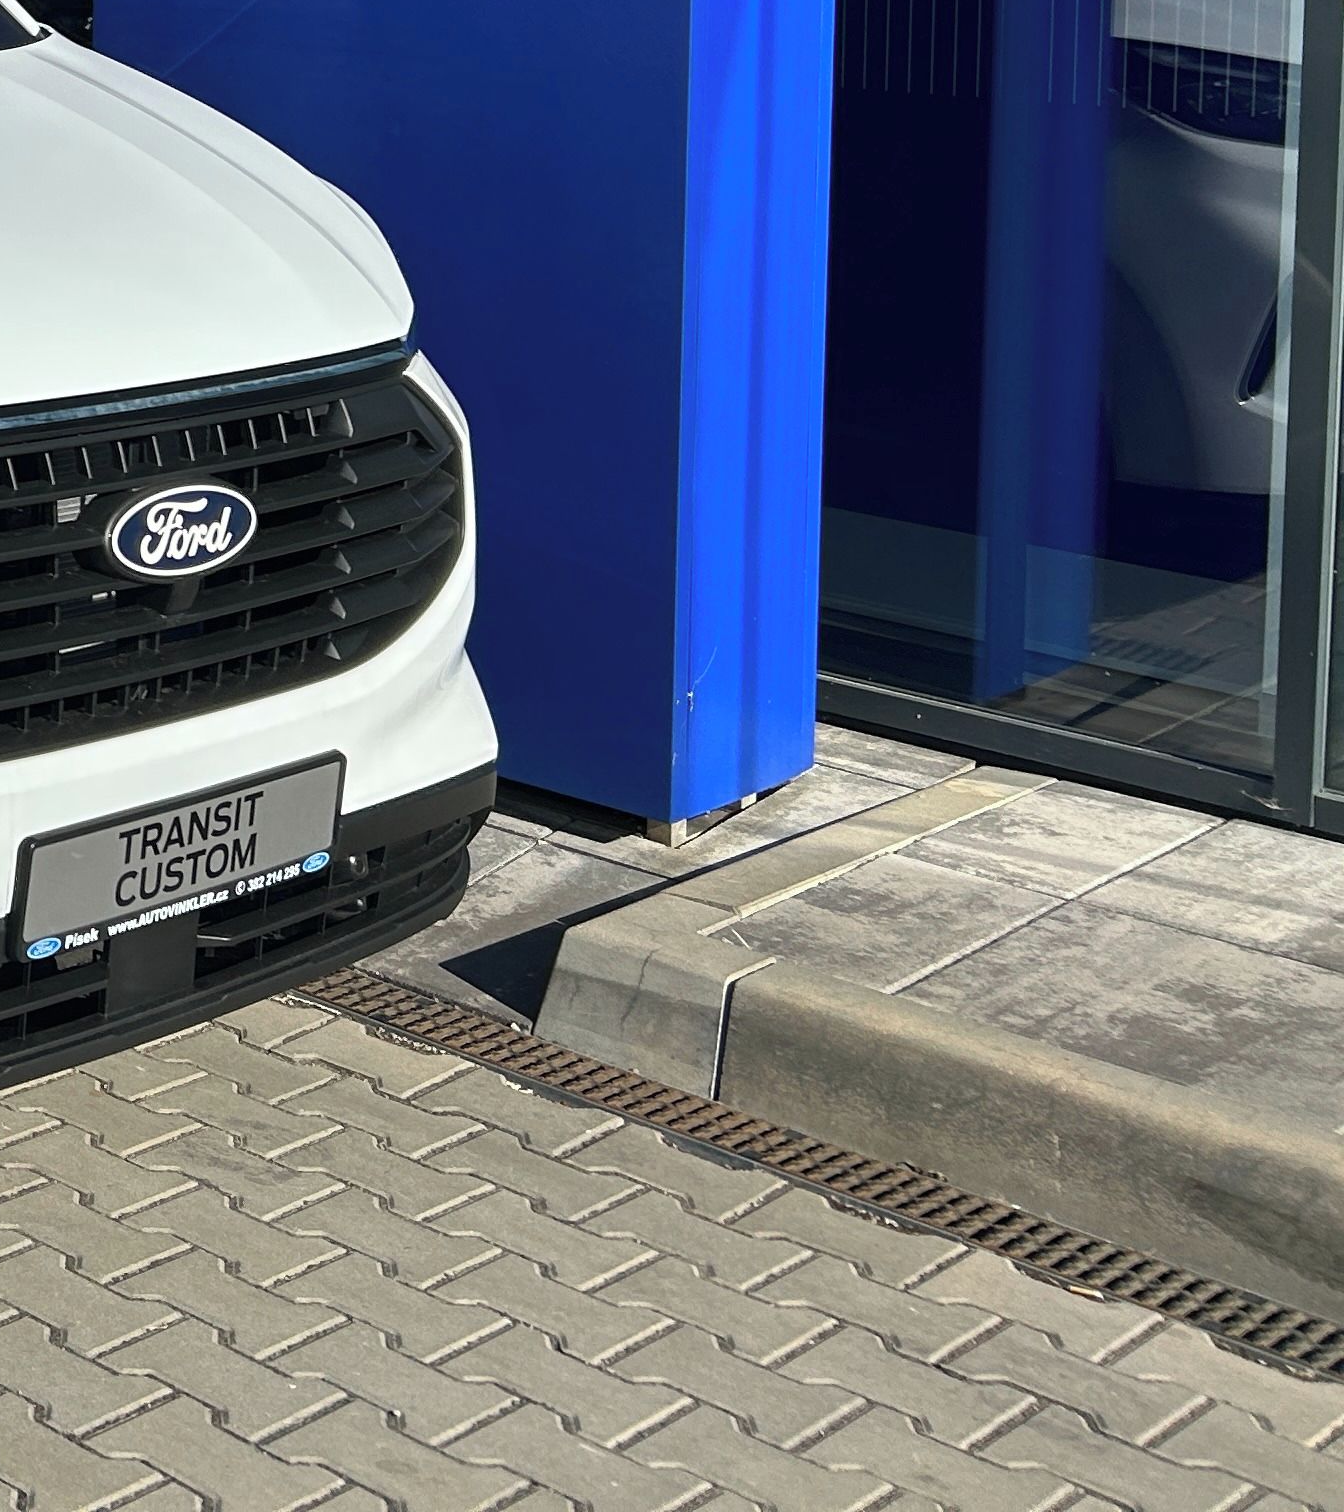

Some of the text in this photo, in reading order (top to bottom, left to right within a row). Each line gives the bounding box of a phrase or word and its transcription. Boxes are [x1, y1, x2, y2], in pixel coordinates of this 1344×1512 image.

[139, 496, 234, 565] Ford
[118, 790, 264, 865] TRANSIT
[115, 833, 258, 907] CUSTOM
